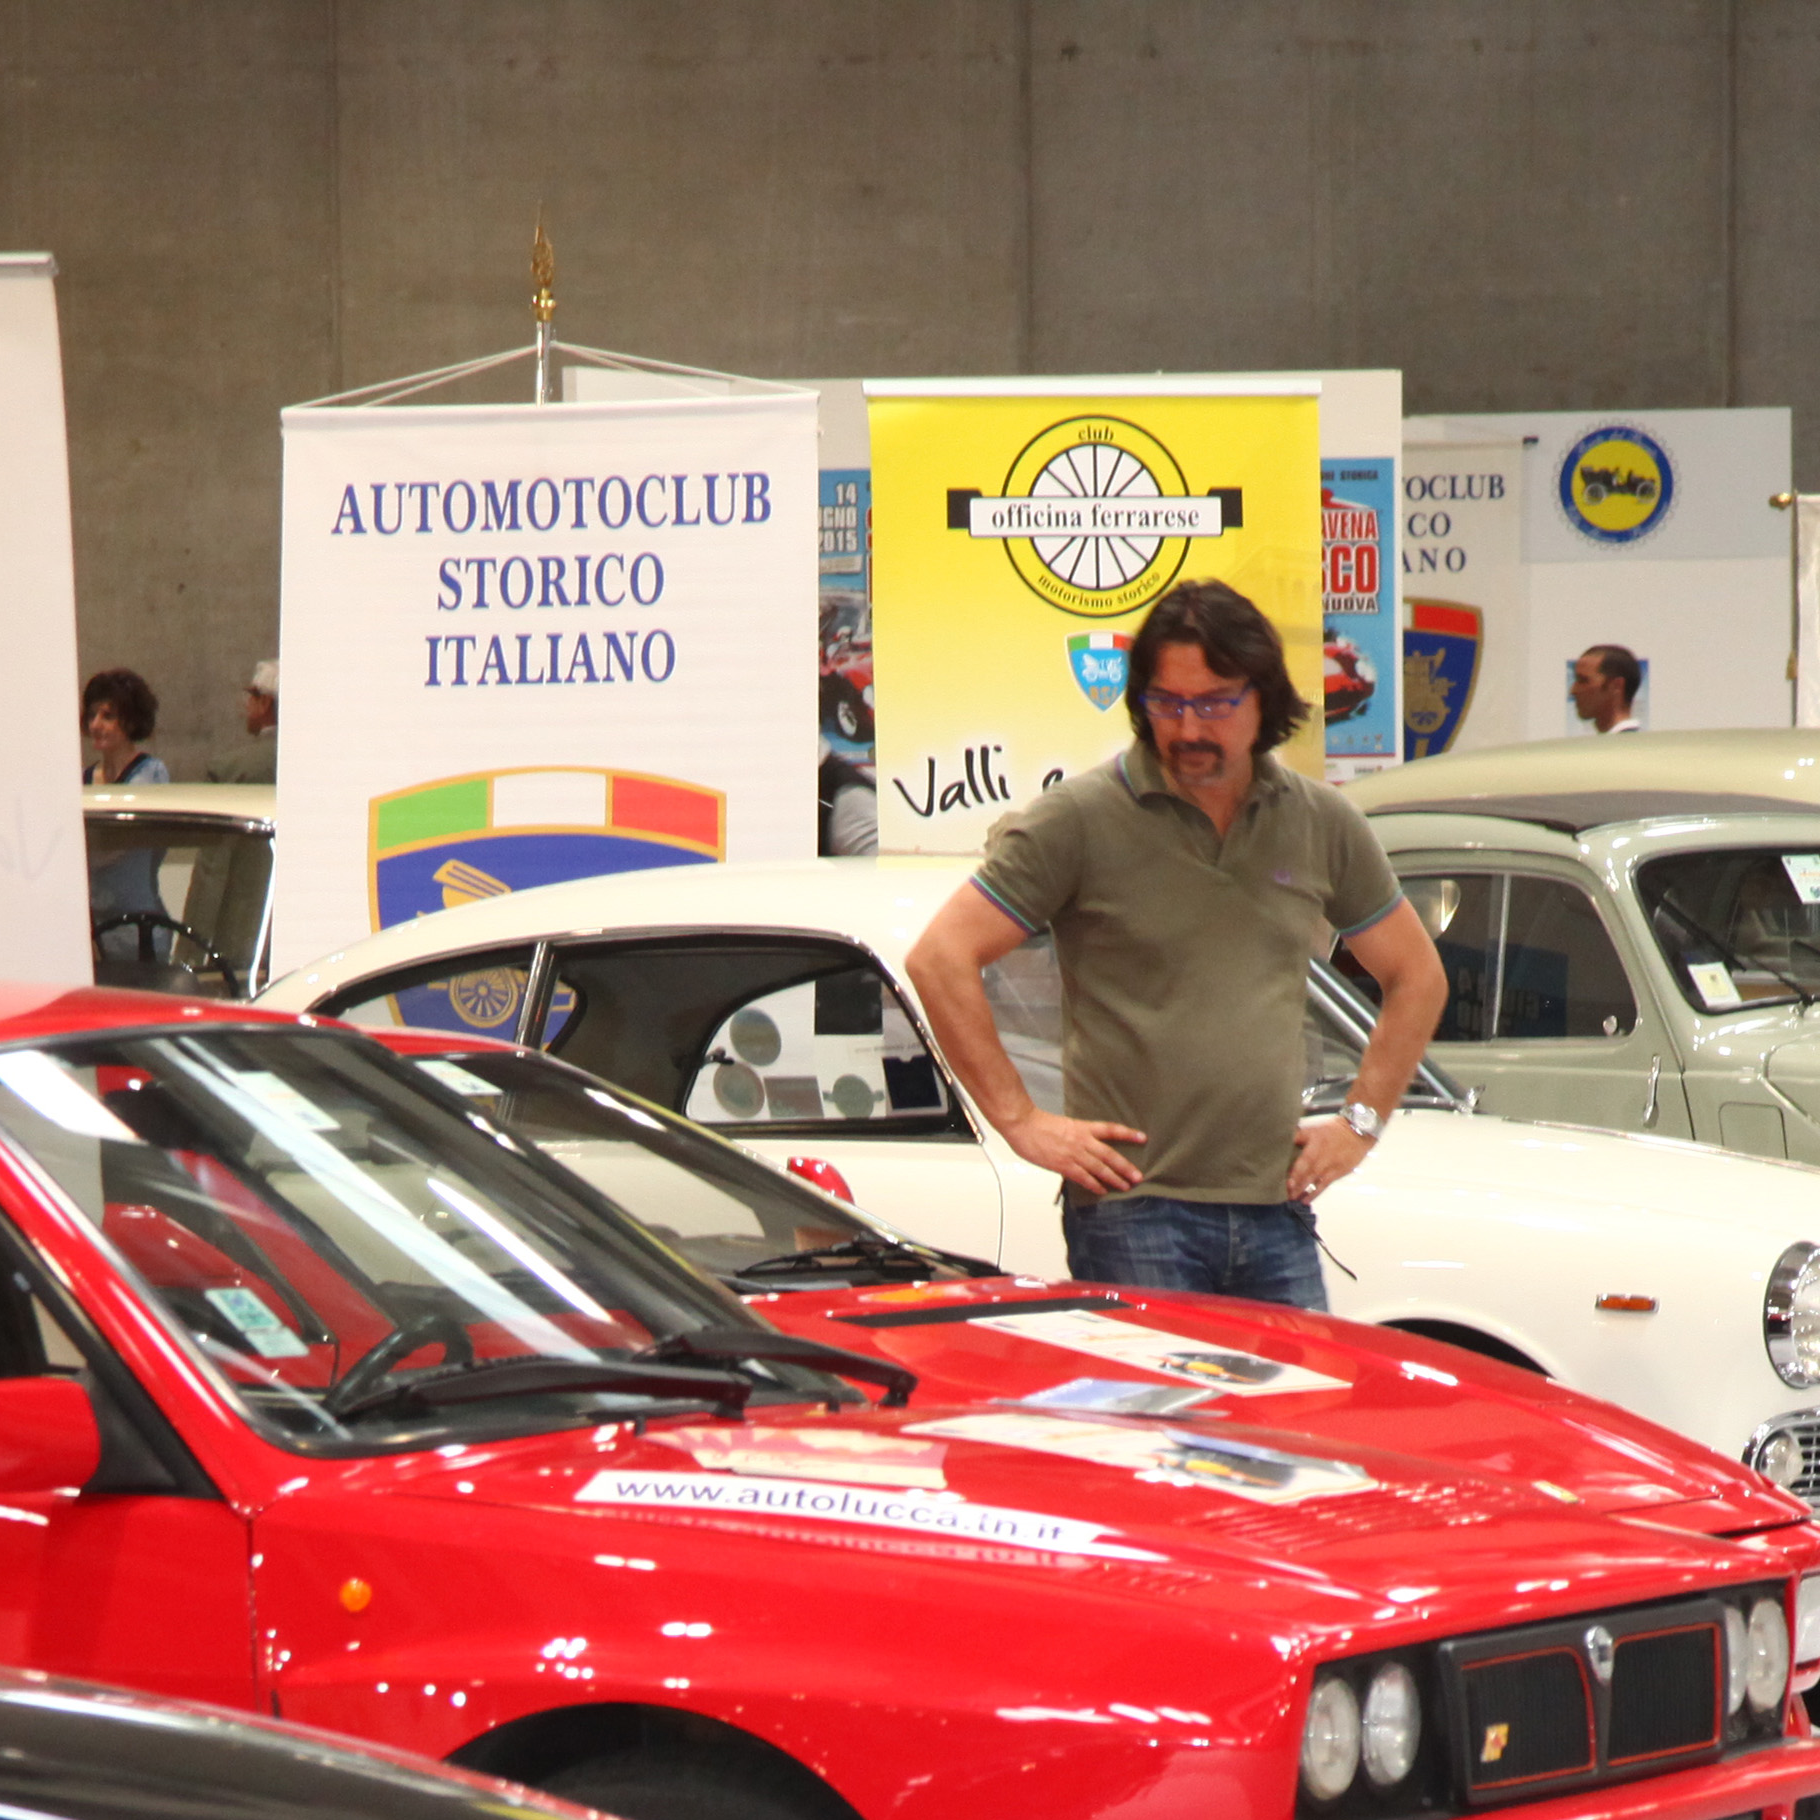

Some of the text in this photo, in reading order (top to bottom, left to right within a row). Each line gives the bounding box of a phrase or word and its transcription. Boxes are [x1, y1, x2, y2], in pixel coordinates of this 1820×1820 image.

[1078, 424, 1114, 443] club
[330, 471, 773, 536] AUTOMOTOCLUB
[836, 482, 858, 506] 14
[1403, 473, 1506, 501] OCLUB
[991, 503, 1201, 529] officina ferrarese
[1404, 511, 1453, 539] CO
[436, 551, 666, 611] STORICO
[1037, 571, 1161, 609] motorismo storico
[1321, 544, 1379, 595] CO
[424, 628, 677, 688] ITALIANO
[891, 743, 1011, 818] Valli
[614, 1480, 1066, 1542] www.autolucca.tn.it
